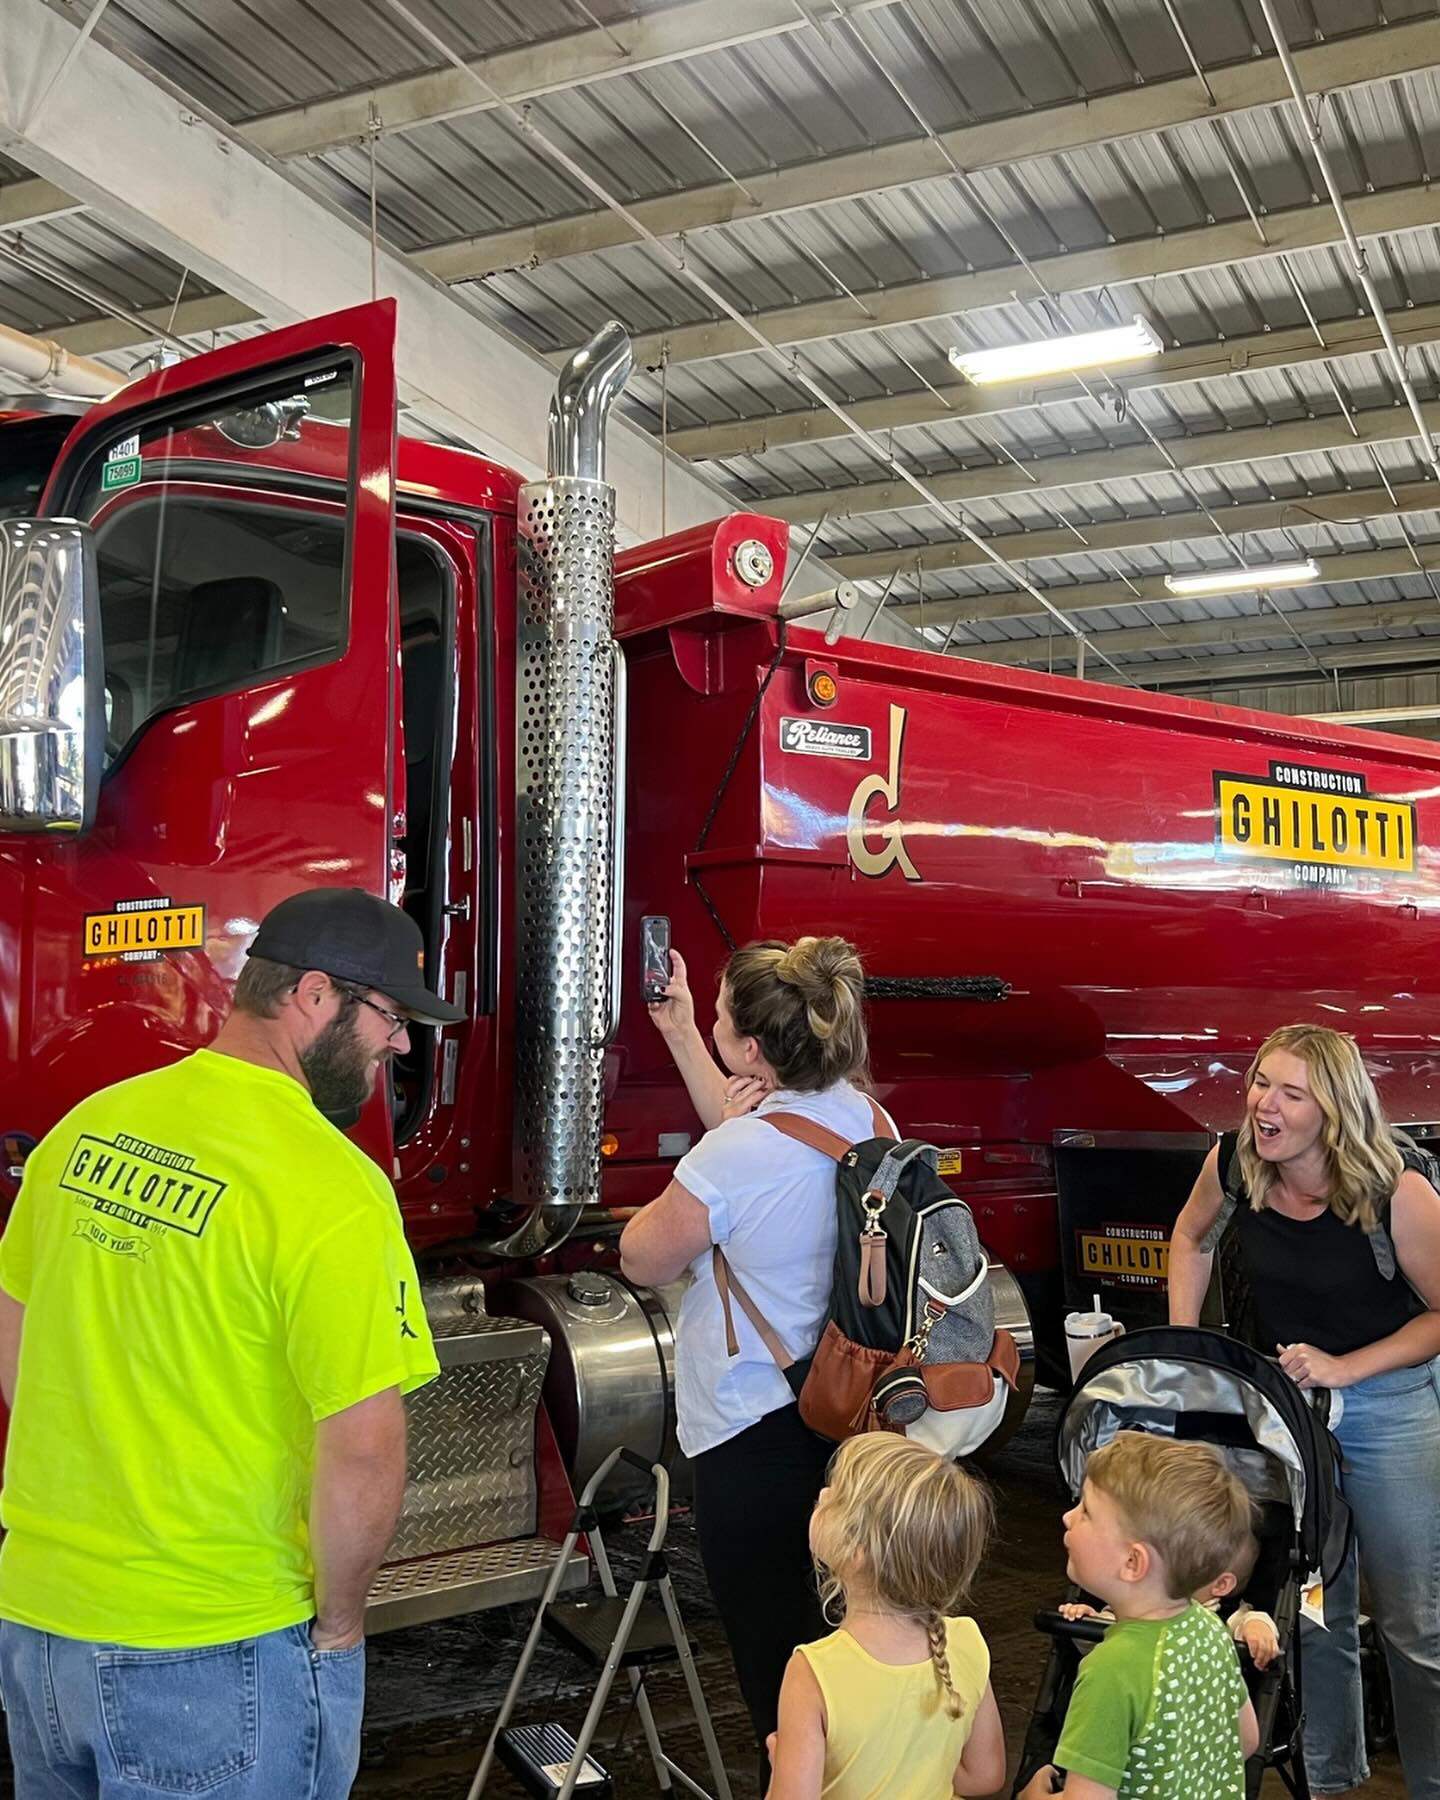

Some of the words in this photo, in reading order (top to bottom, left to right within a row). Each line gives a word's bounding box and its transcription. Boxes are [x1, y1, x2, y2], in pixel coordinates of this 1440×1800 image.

[786, 721, 862, 747] Reliance
[1275, 766, 1362, 794] CONSTRUCTION
[1232, 793, 1405, 860] GHILOTTI
[1293, 864, 1348, 885] COMPANY
[116, 898, 170, 912] CONSTRUCTION
[92, 913, 197, 946] GHILOTTI
[123, 950, 158, 961] COMPANY
[115, 1135, 193, 1171] CONSTRUCTION
[73, 1149, 208, 1219] GHILOTTI
[90, 1223, 107, 1244] 100
[1106, 1227, 1164, 1240] CONSTRUCTION
[1087, 1243, 1170, 1271] GHILOT
[1120, 1275, 1155, 1285] COMPANY
